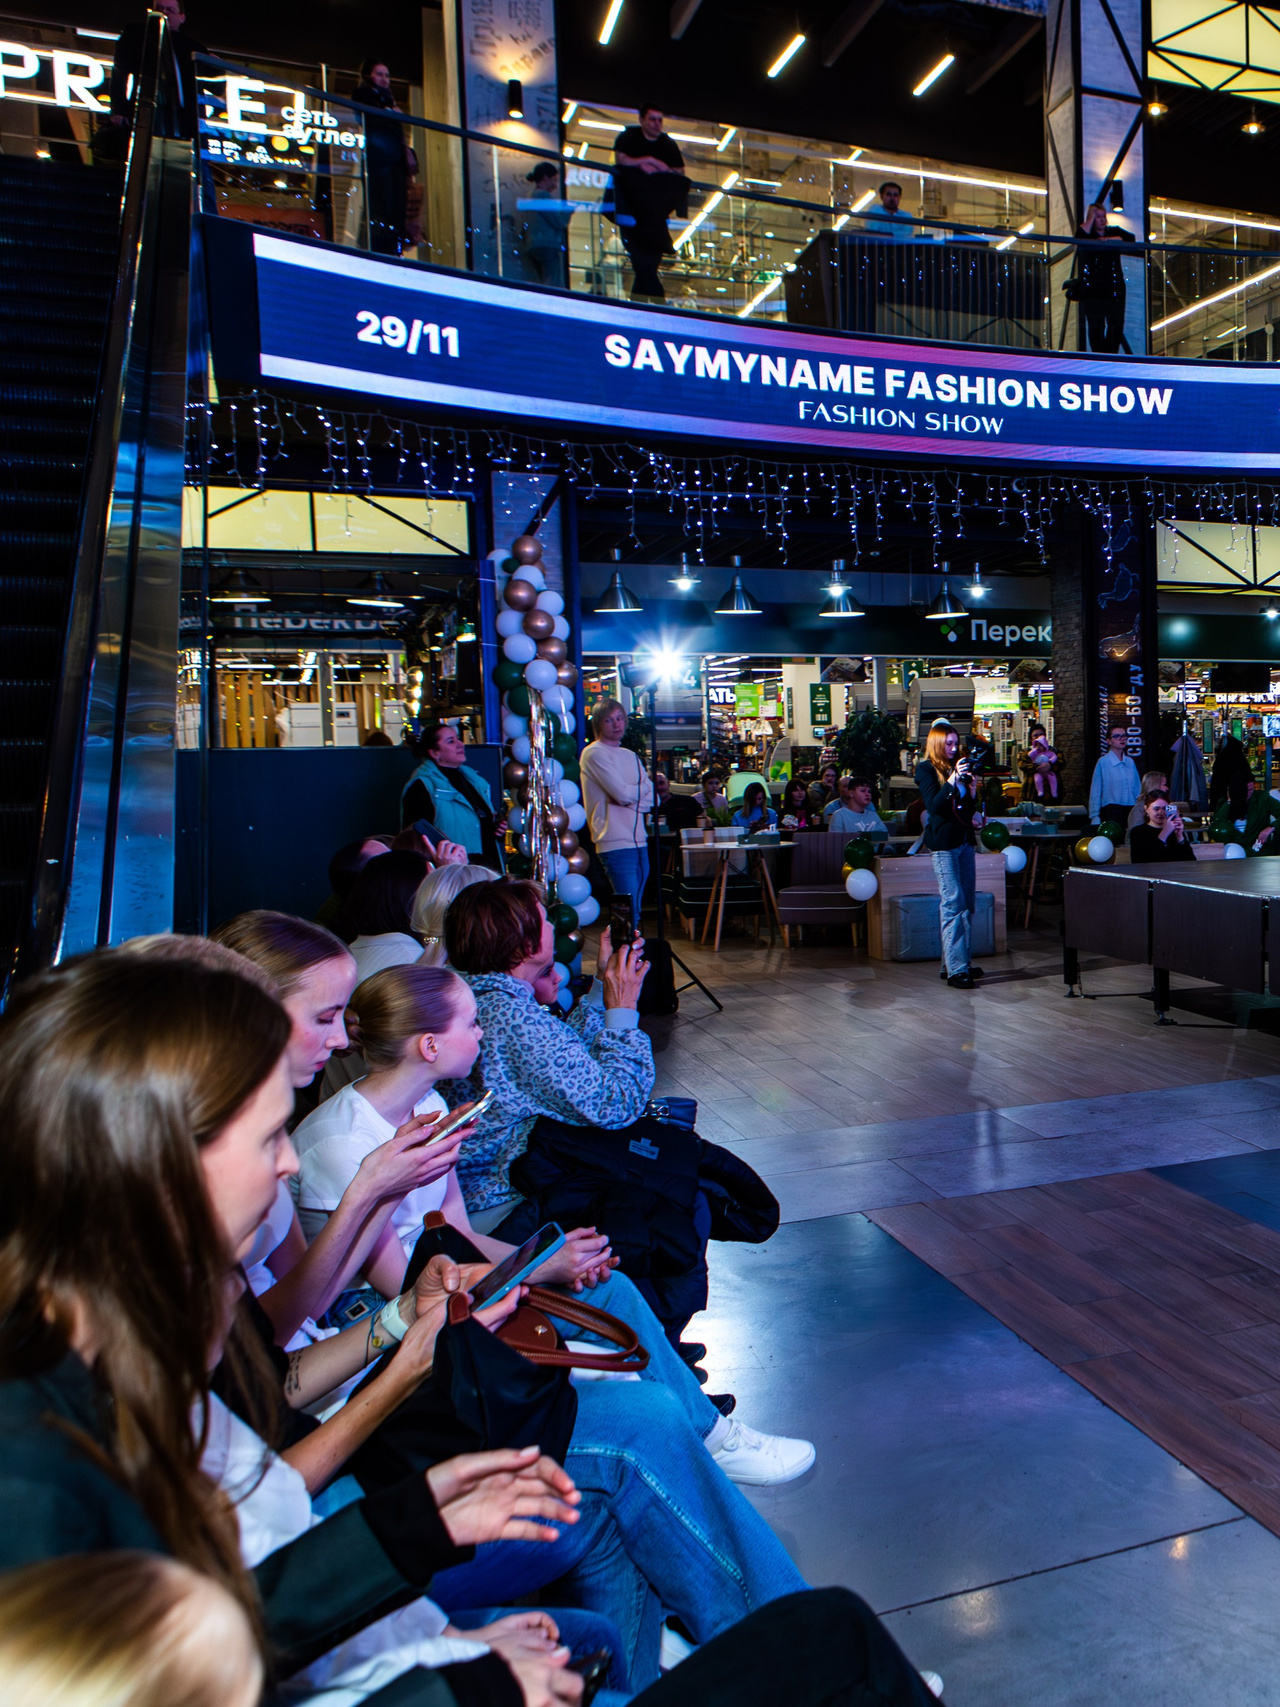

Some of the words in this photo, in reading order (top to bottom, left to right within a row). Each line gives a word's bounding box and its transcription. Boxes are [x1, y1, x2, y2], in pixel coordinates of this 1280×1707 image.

[280, 105, 340, 146] сеть
[356, 310, 460, 358] 29/11
[604, 334, 875, 395] SAYMYNAME
[884, 368, 1050, 409] FASHION
[1058, 382, 1174, 415] SHOW
[798, 400, 916, 432] FASHION
[925, 412, 1004, 435] SHOW
[970, 619, 1052, 647] Перек
[682, 669, 697, 687] 4
[1126, 664, 1144, 757] СВО-БО-ДУ
